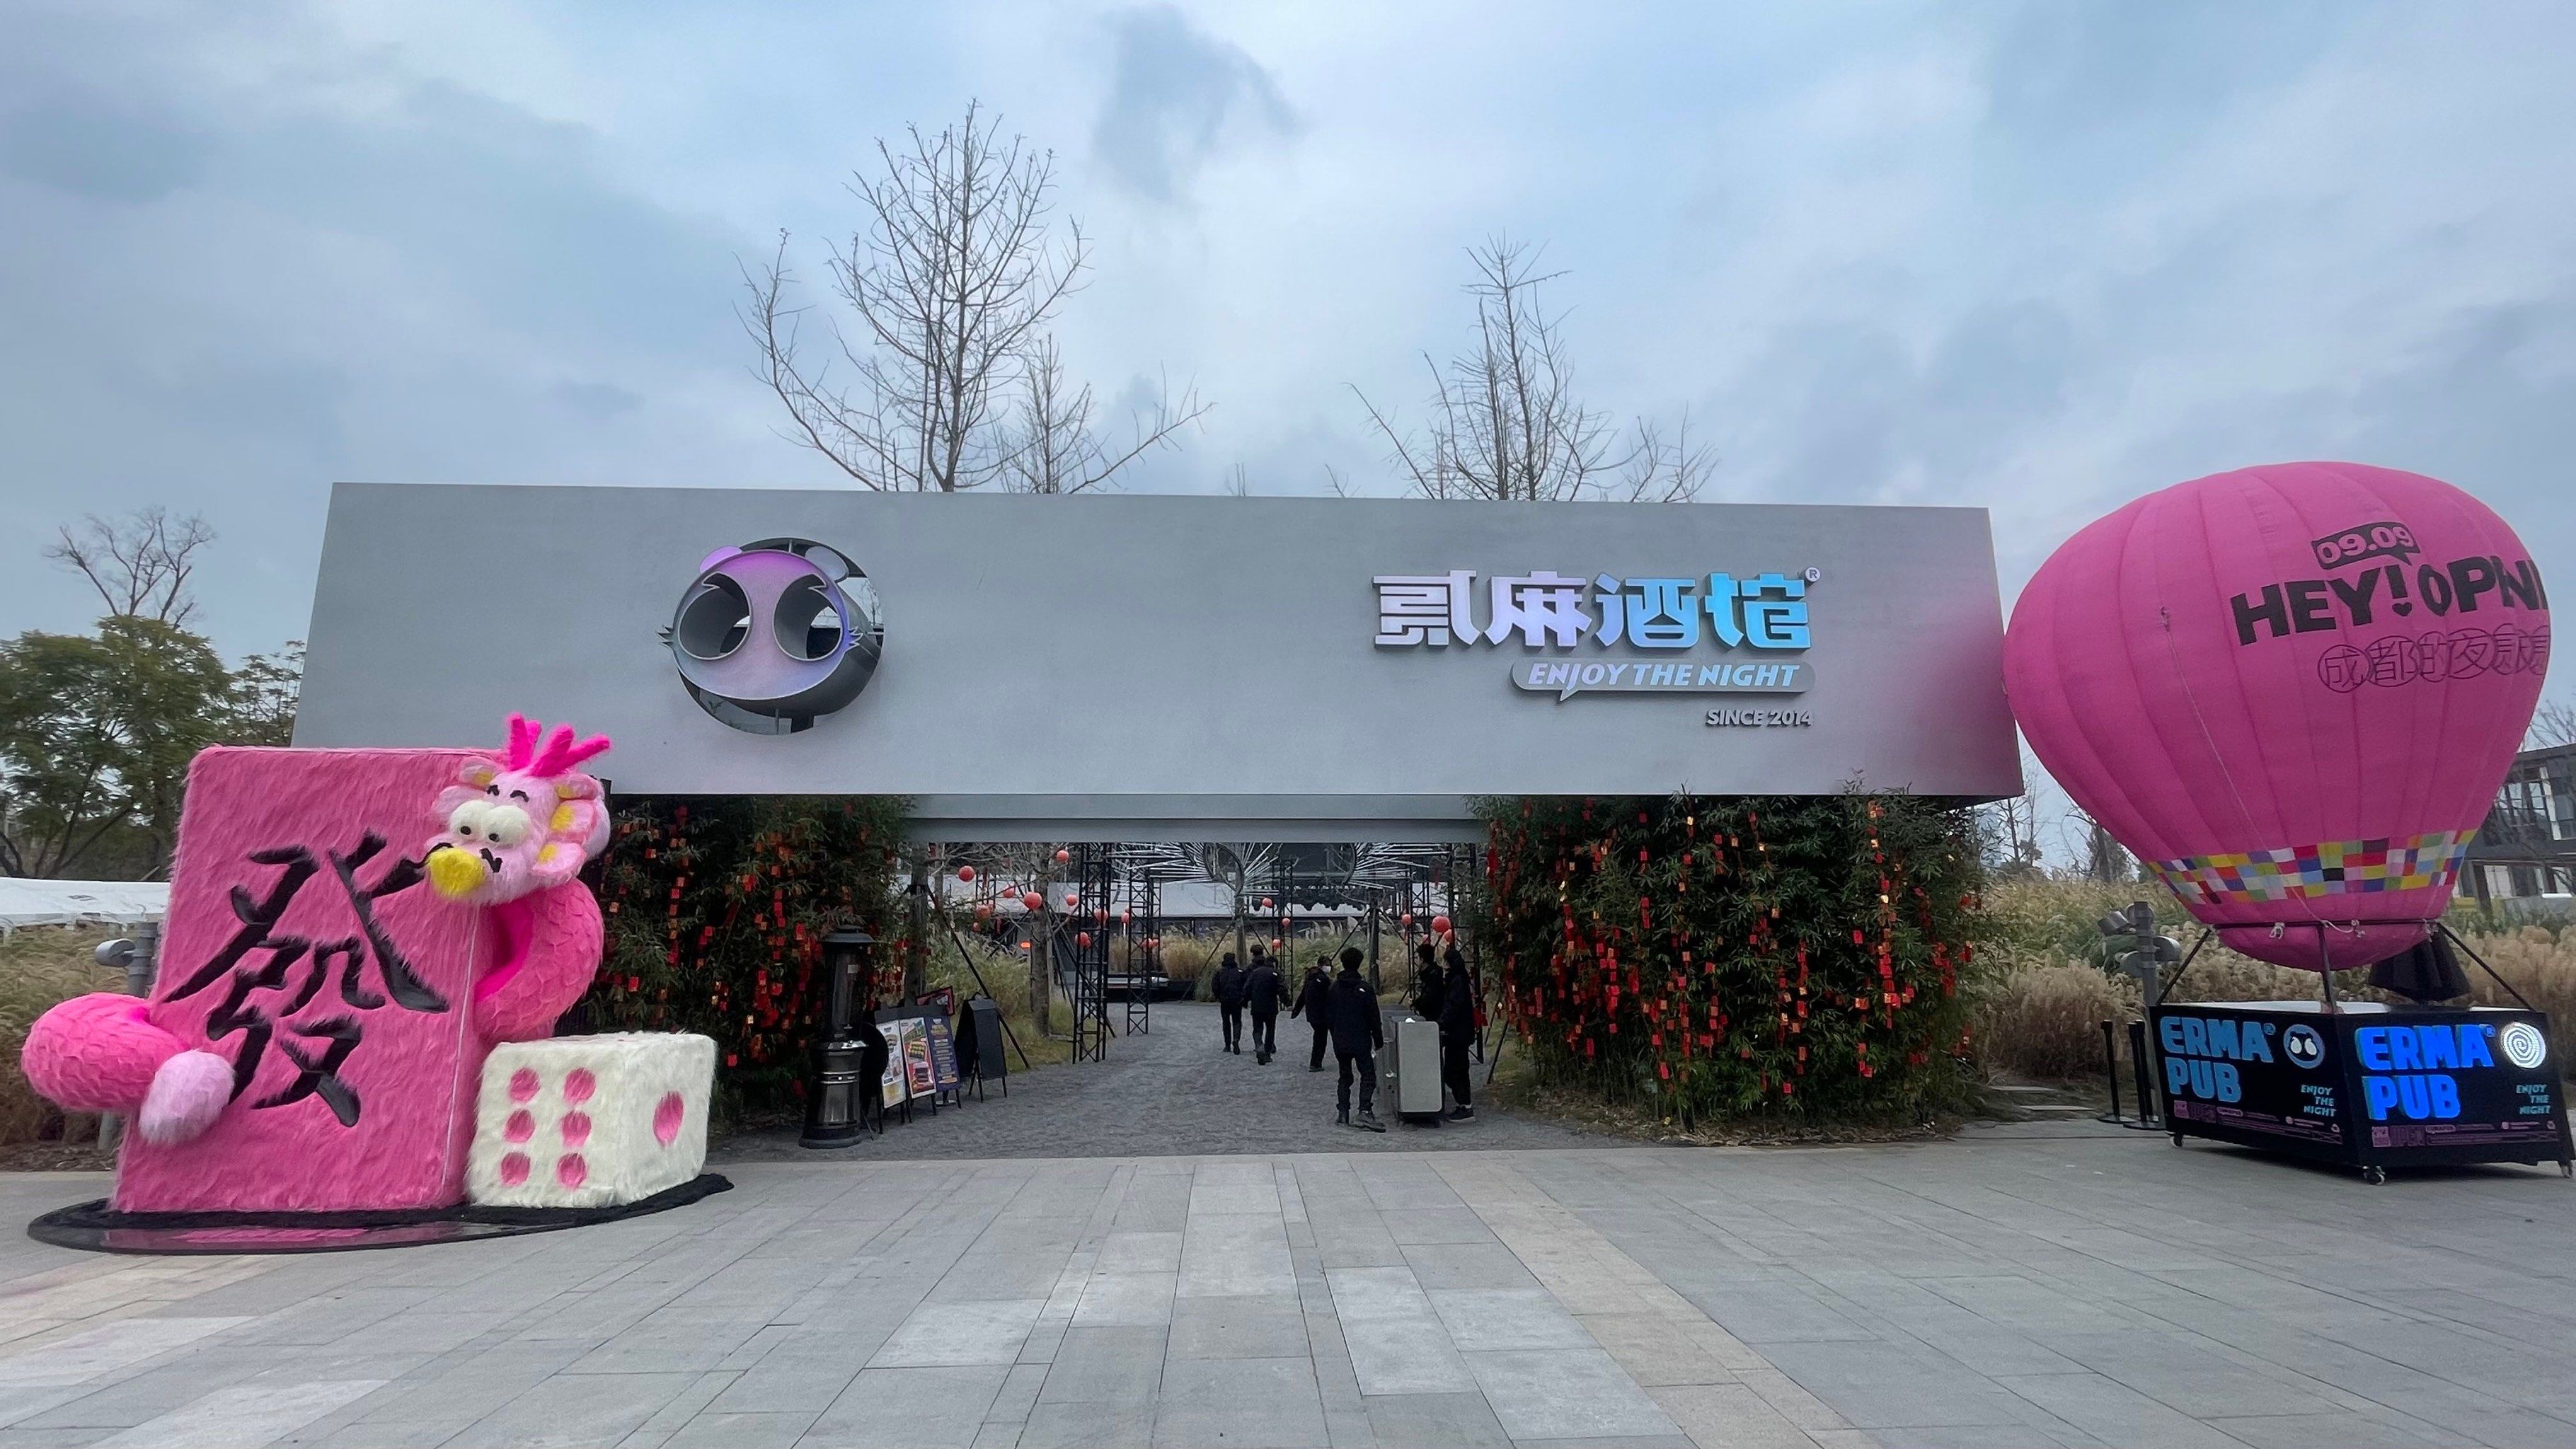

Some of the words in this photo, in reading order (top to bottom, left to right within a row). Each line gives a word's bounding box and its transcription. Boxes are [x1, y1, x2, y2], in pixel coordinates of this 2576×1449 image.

[2316, 526, 2415, 565] 09.09
[2230, 565, 2413, 646] HEY!
[1527, 662, 1629, 691] ENJOY
[1631, 663, 1694, 687] THE
[1696, 664, 1801, 688] NIGHT
[1706, 709, 1767, 726] SINCE
[1769, 710, 1813, 726] 2014
[2160, 1016, 2275, 1063] ERMA
[2354, 1024, 2495, 1070] ERMA
[2164, 1056, 2243, 1104] PUB
[2301, 1085, 2333, 1096] ENJOY
[2516, 1085, 2546, 1095] ENJOY
[2314, 1097, 2335, 1106] THE
[2361, 1074, 2461, 1121] PUB
[2531, 1095, 2549, 1104] THE
[2304, 1106, 2337, 1117] NIGHT
[2519, 1105, 2551, 1115] NIGHT
